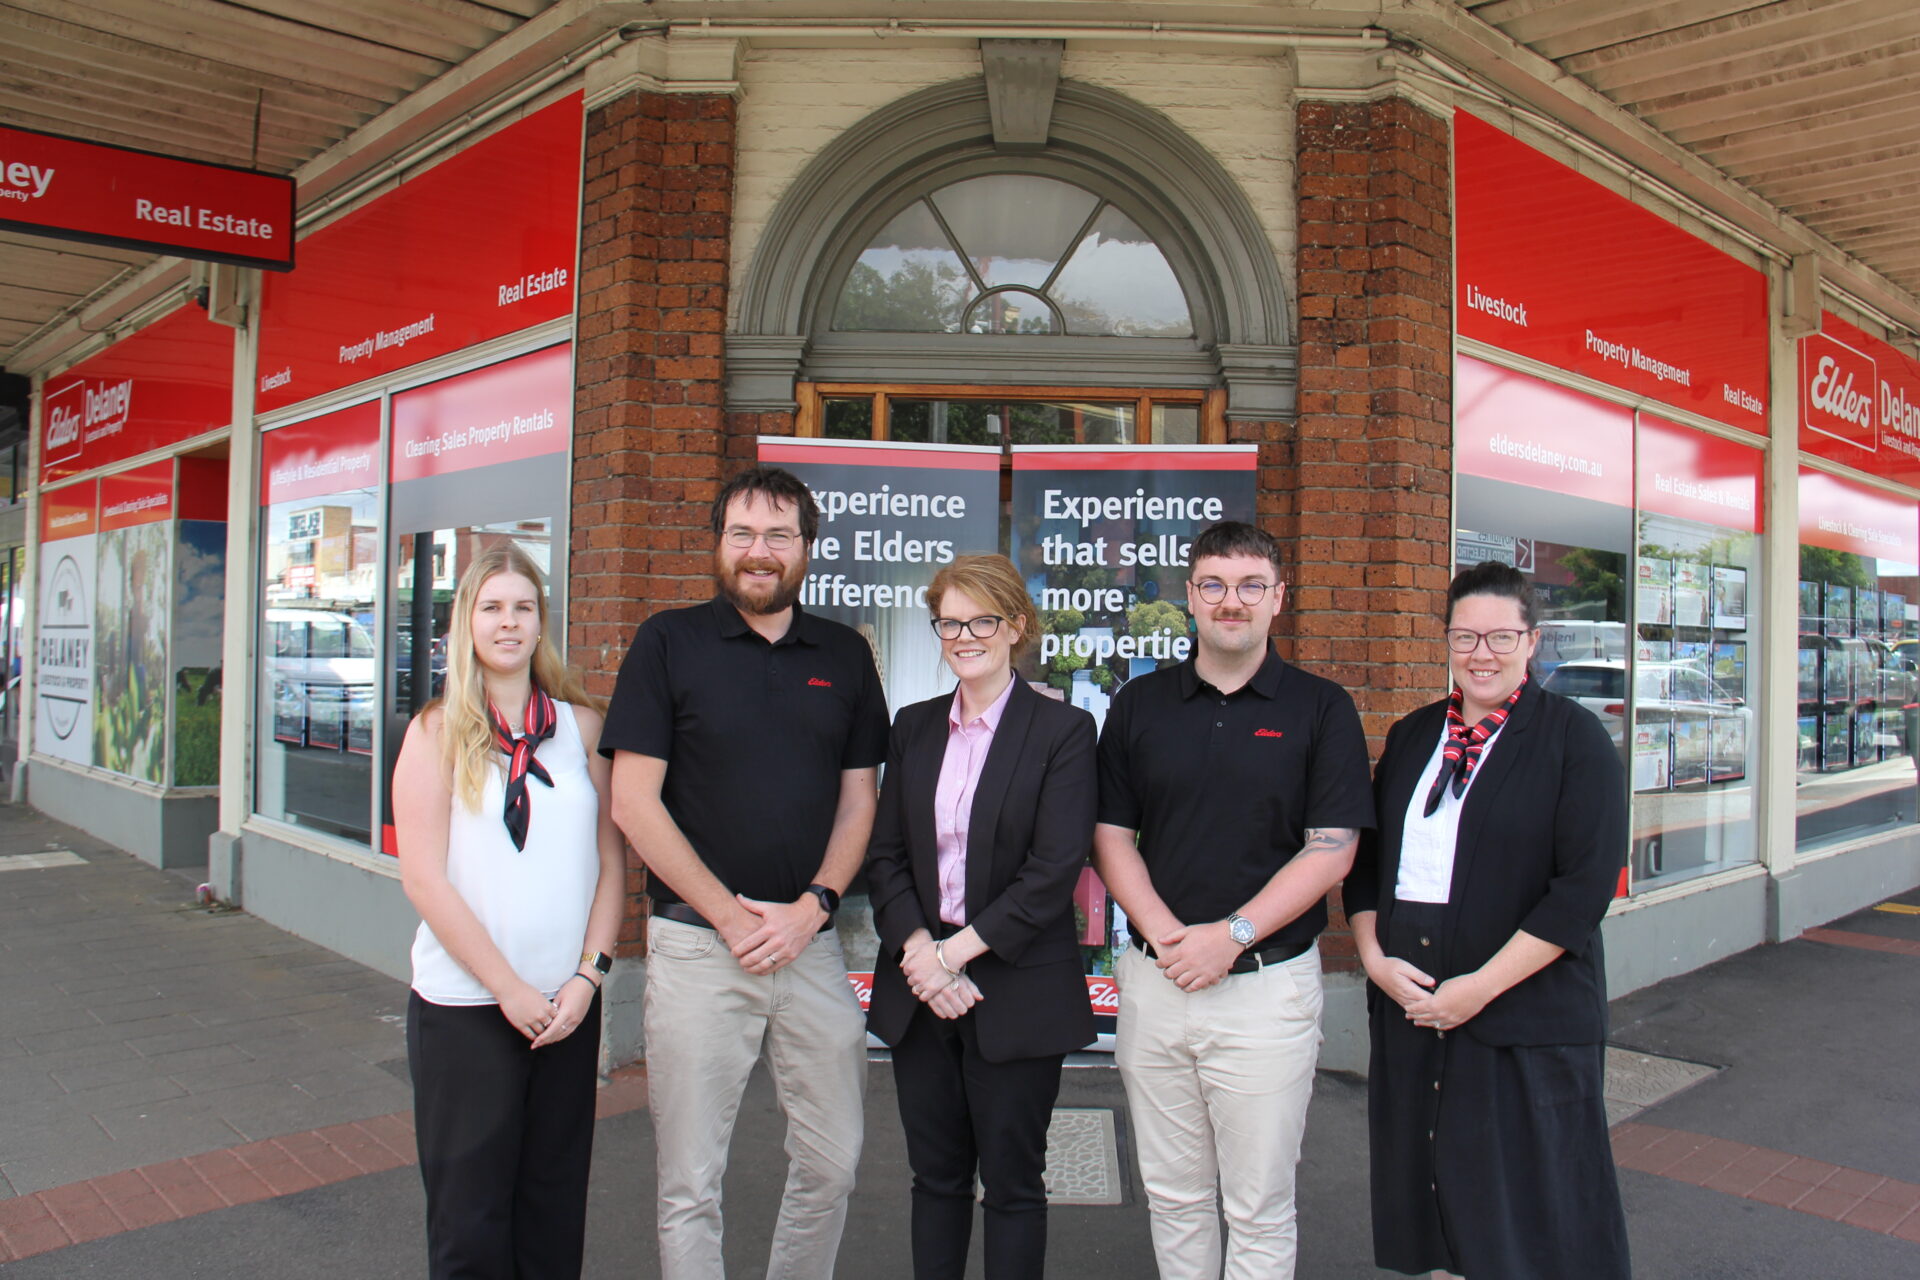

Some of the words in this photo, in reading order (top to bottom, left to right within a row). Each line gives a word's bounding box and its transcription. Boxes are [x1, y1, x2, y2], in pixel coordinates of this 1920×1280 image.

[0, 160, 56, 198] ey
[135, 198, 191, 227] Real
[197, 208, 273, 239] Estate
[498, 284, 524, 307] Real
[526, 267, 568, 297] Estate
[1467, 283, 1529, 328] Livestock
[338, 337, 375, 364] Property
[375, 312, 435, 351] Management
[1586, 328, 1630, 369] Property
[1631, 346, 1691, 388] Management
[261, 366, 292, 392] Livestock
[1811, 355, 1873, 429] Elders
[84, 379, 133, 428] Delaney
[1723, 383, 1740, 407] Real
[1741, 390, 1763, 416] Estate
[47, 405, 82, 450] Elders
[405, 435, 441, 457] Clearing
[441, 429, 468, 451] Sales
[468, 420, 512, 448] Property
[513, 408, 554, 436] Rentals
[340, 452, 371, 474] Property
[1489, 432, 1603, 477] eldersdelaney.com.au
[804, 483, 966, 522] xperience
[1044, 488, 1223, 528] Experience
[1655, 473, 1672, 494] Real
[1673, 477, 1697, 500] Estate
[1697, 483, 1718, 504] Sales
[854, 529, 954, 564] Elders
[1042, 534, 1108, 566] that
[1042, 588, 1124, 612] more
[1040, 628, 1191, 666] propertie
